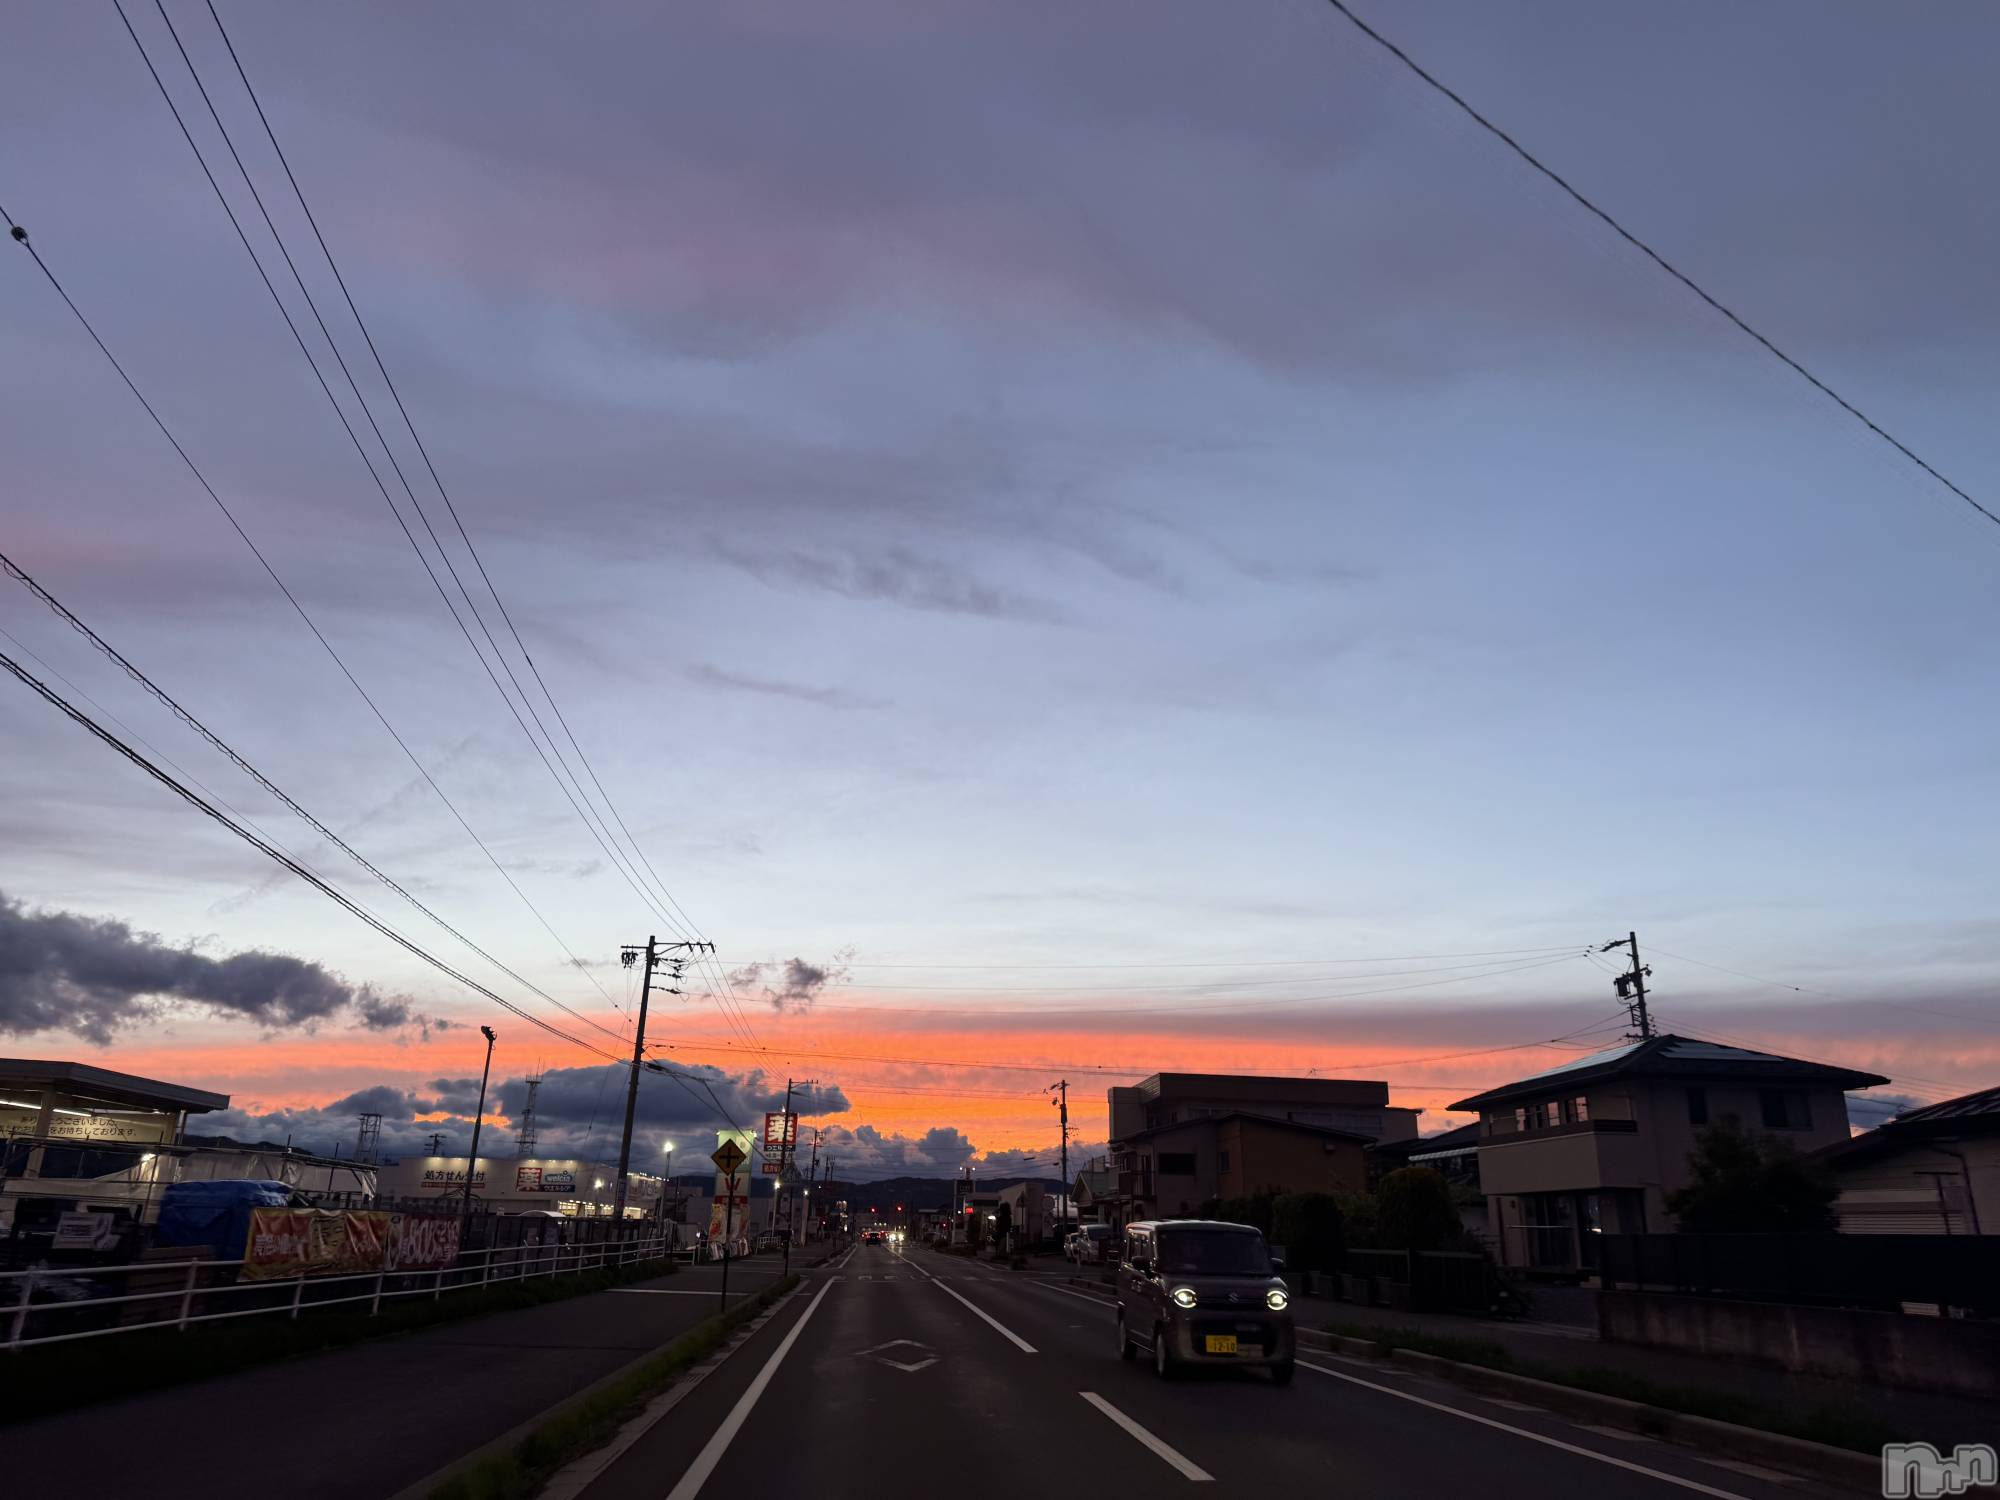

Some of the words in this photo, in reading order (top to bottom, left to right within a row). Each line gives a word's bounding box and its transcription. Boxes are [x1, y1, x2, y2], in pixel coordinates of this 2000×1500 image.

[424, 1170, 485, 1181] 処方せん付
